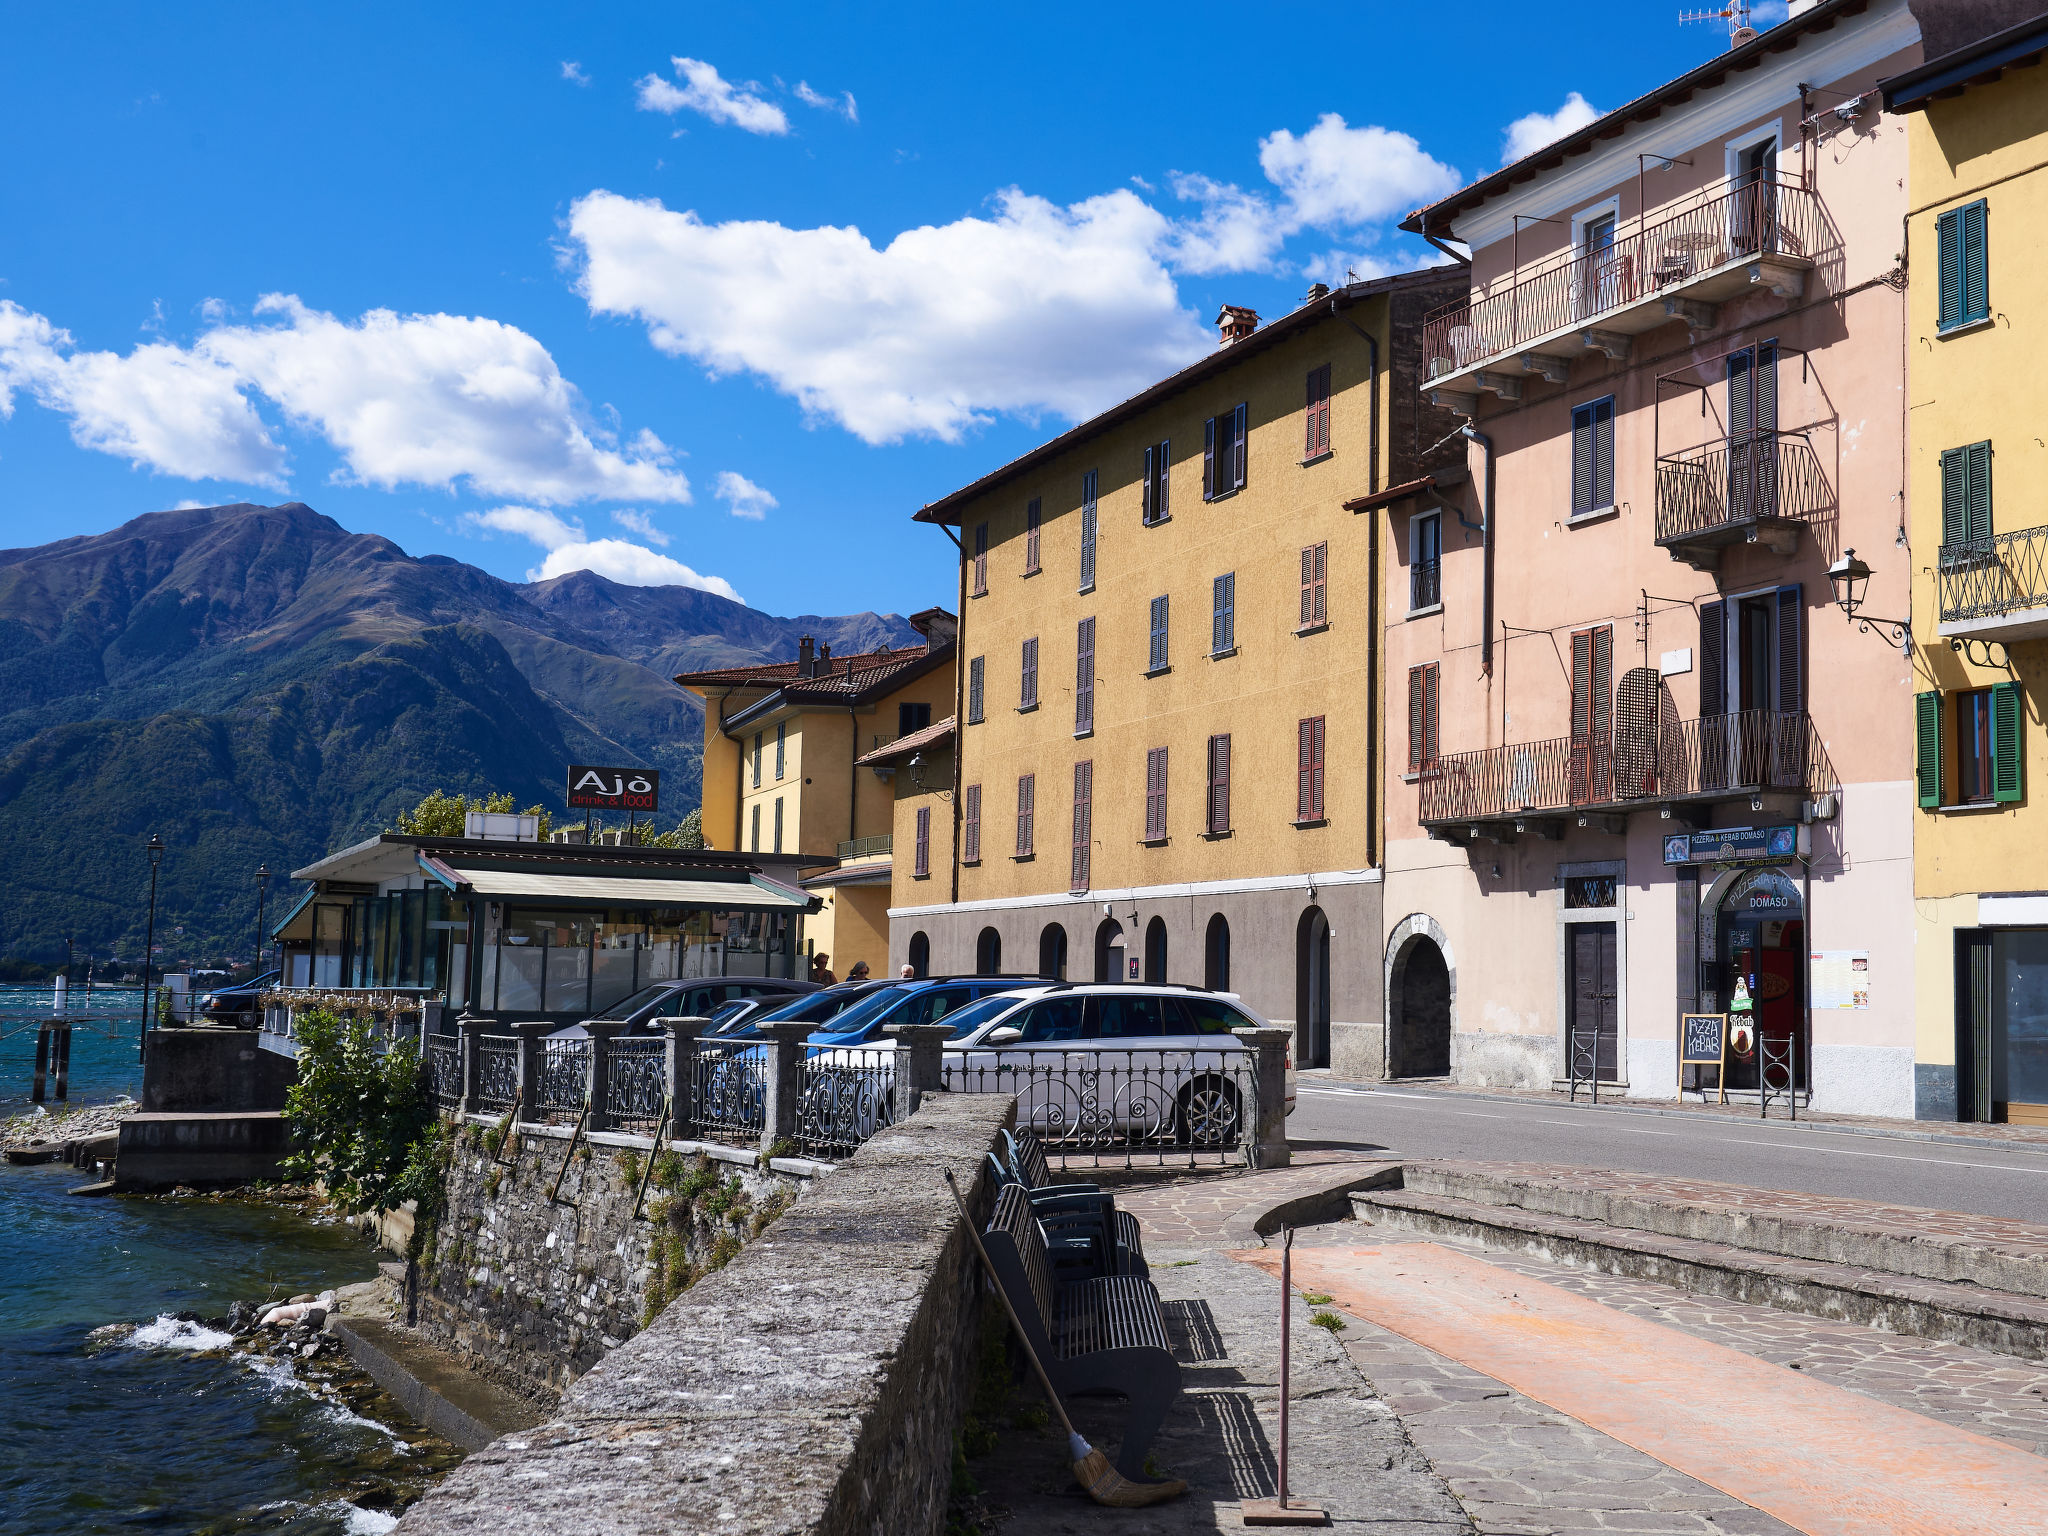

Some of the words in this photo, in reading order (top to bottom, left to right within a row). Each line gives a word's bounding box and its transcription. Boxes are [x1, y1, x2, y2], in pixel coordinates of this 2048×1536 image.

[574, 770, 652, 796] Ajò
[572, 795, 604, 806] drink
[608, 796, 619, 806] &
[623, 791, 653, 808] food
[1691, 836, 1715, 844] PIZZERIA
[1720, 832, 1740, 842] KEBAB
[1740, 830, 1765, 840] DOMASO
[1729, 873, 1770, 907] PIZZERIA
[1772, 873, 1778, 885] &
[1780, 875, 1801, 896] KEB
[1750, 897, 1788, 908] DOMASO
[1730, 1014, 1755, 1028] Kebab
